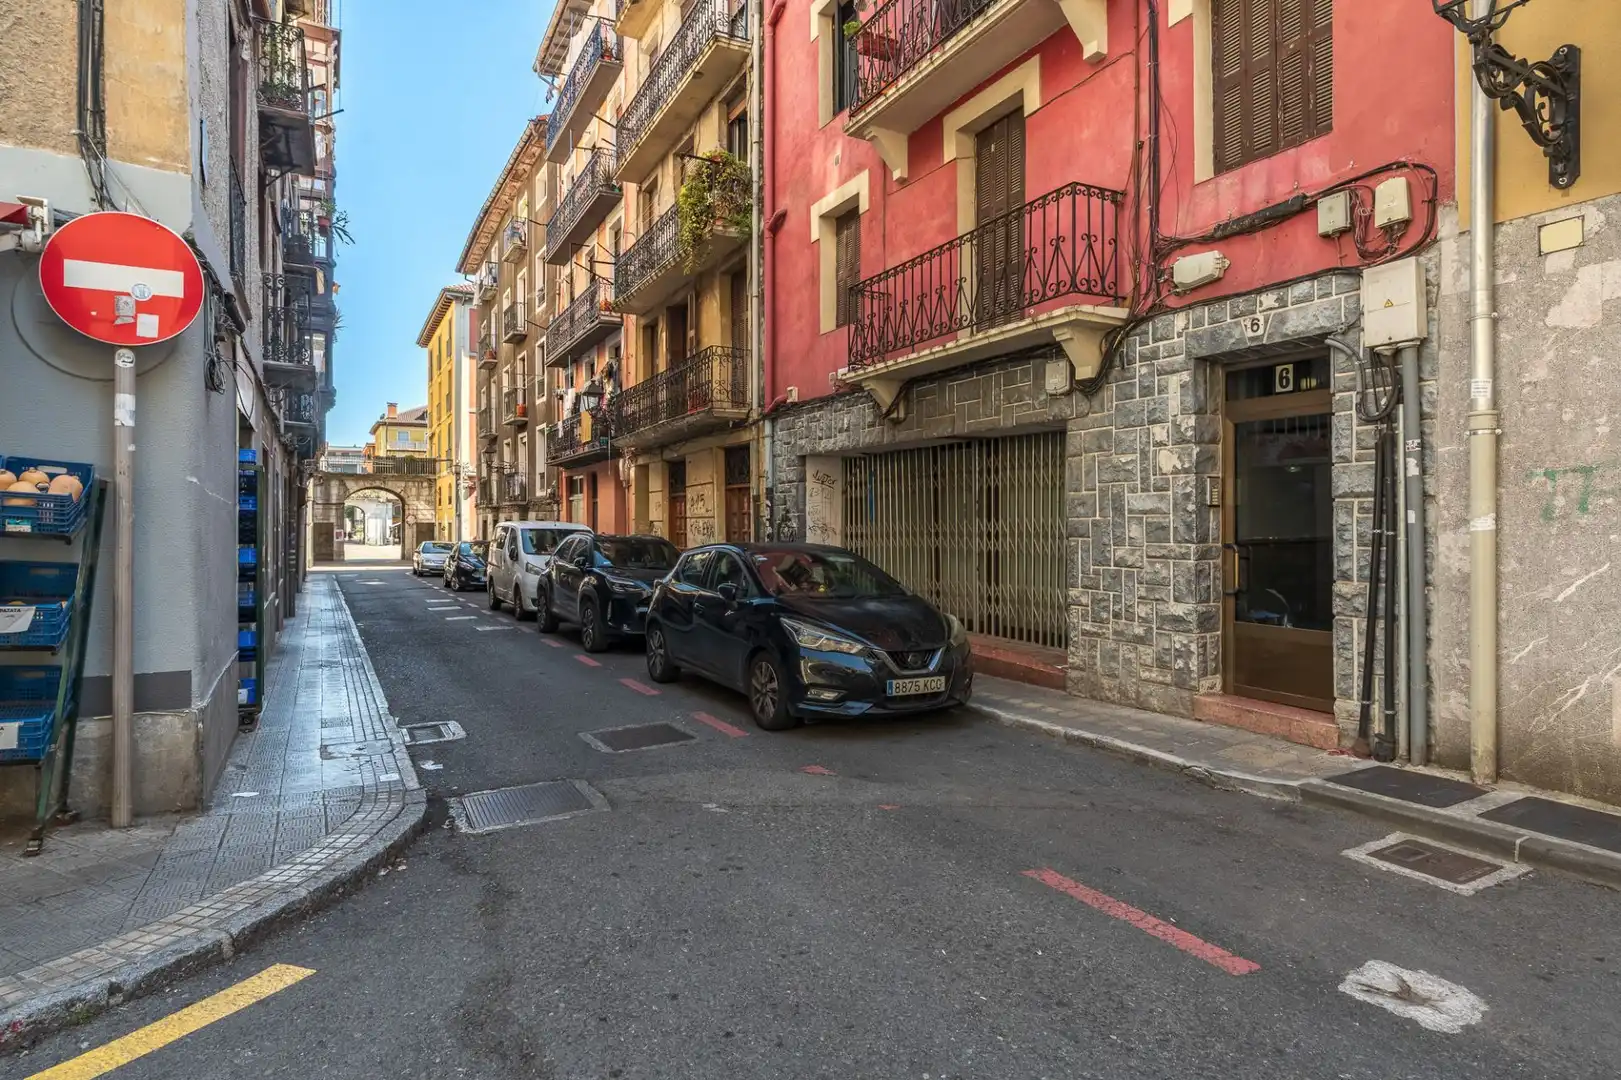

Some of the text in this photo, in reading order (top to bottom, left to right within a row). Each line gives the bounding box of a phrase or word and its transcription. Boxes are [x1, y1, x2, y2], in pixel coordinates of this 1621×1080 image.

[1251, 318, 1260, 333] 6
[1279, 367, 1290, 389] 6
[895, 681, 920, 693] 8875
